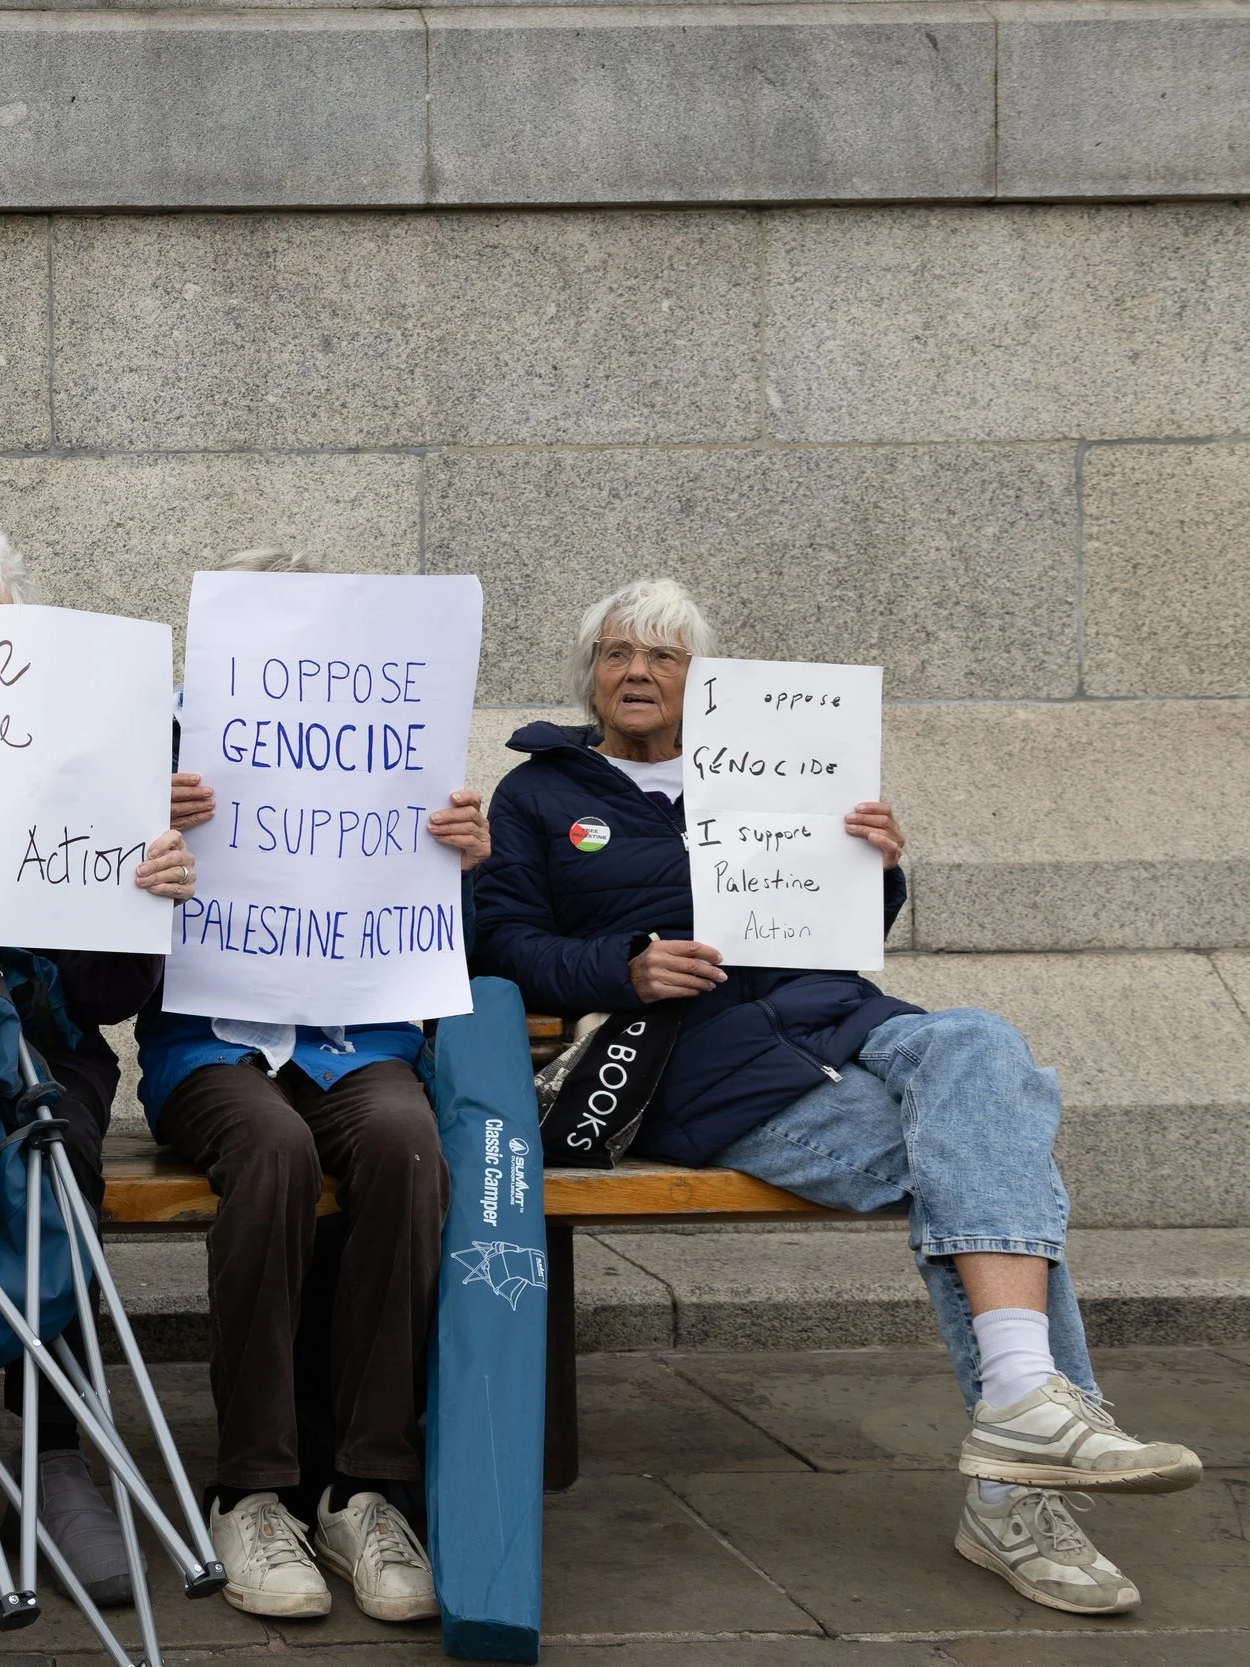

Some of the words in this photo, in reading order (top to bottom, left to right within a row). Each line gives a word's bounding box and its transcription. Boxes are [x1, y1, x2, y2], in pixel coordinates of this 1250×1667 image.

[232, 657, 234, 696] I
[263, 659, 426, 703] OPPOSE
[704, 678, 717, 715] I
[765, 693, 840, 710] oppose
[223, 719, 425, 773] GENOCIDE
[229, 802, 240, 848] I
[257, 806, 426, 858] SUPPORT
[697, 819, 721, 846] I
[739, 826, 811, 851] support
[17, 825, 146, 887] Action
[715, 861, 819, 893] Palestine
[182, 897, 347, 959] PALESTINE
[360, 904, 454, 959] ACTION
[745, 911, 810, 939] Action
[567, 1044, 637, 1151] BOOKS
[485, 1118, 503, 1164] Classic
[480, 1167, 502, 1227] Camper
[515, 1156, 529, 1207] SUMMIT
